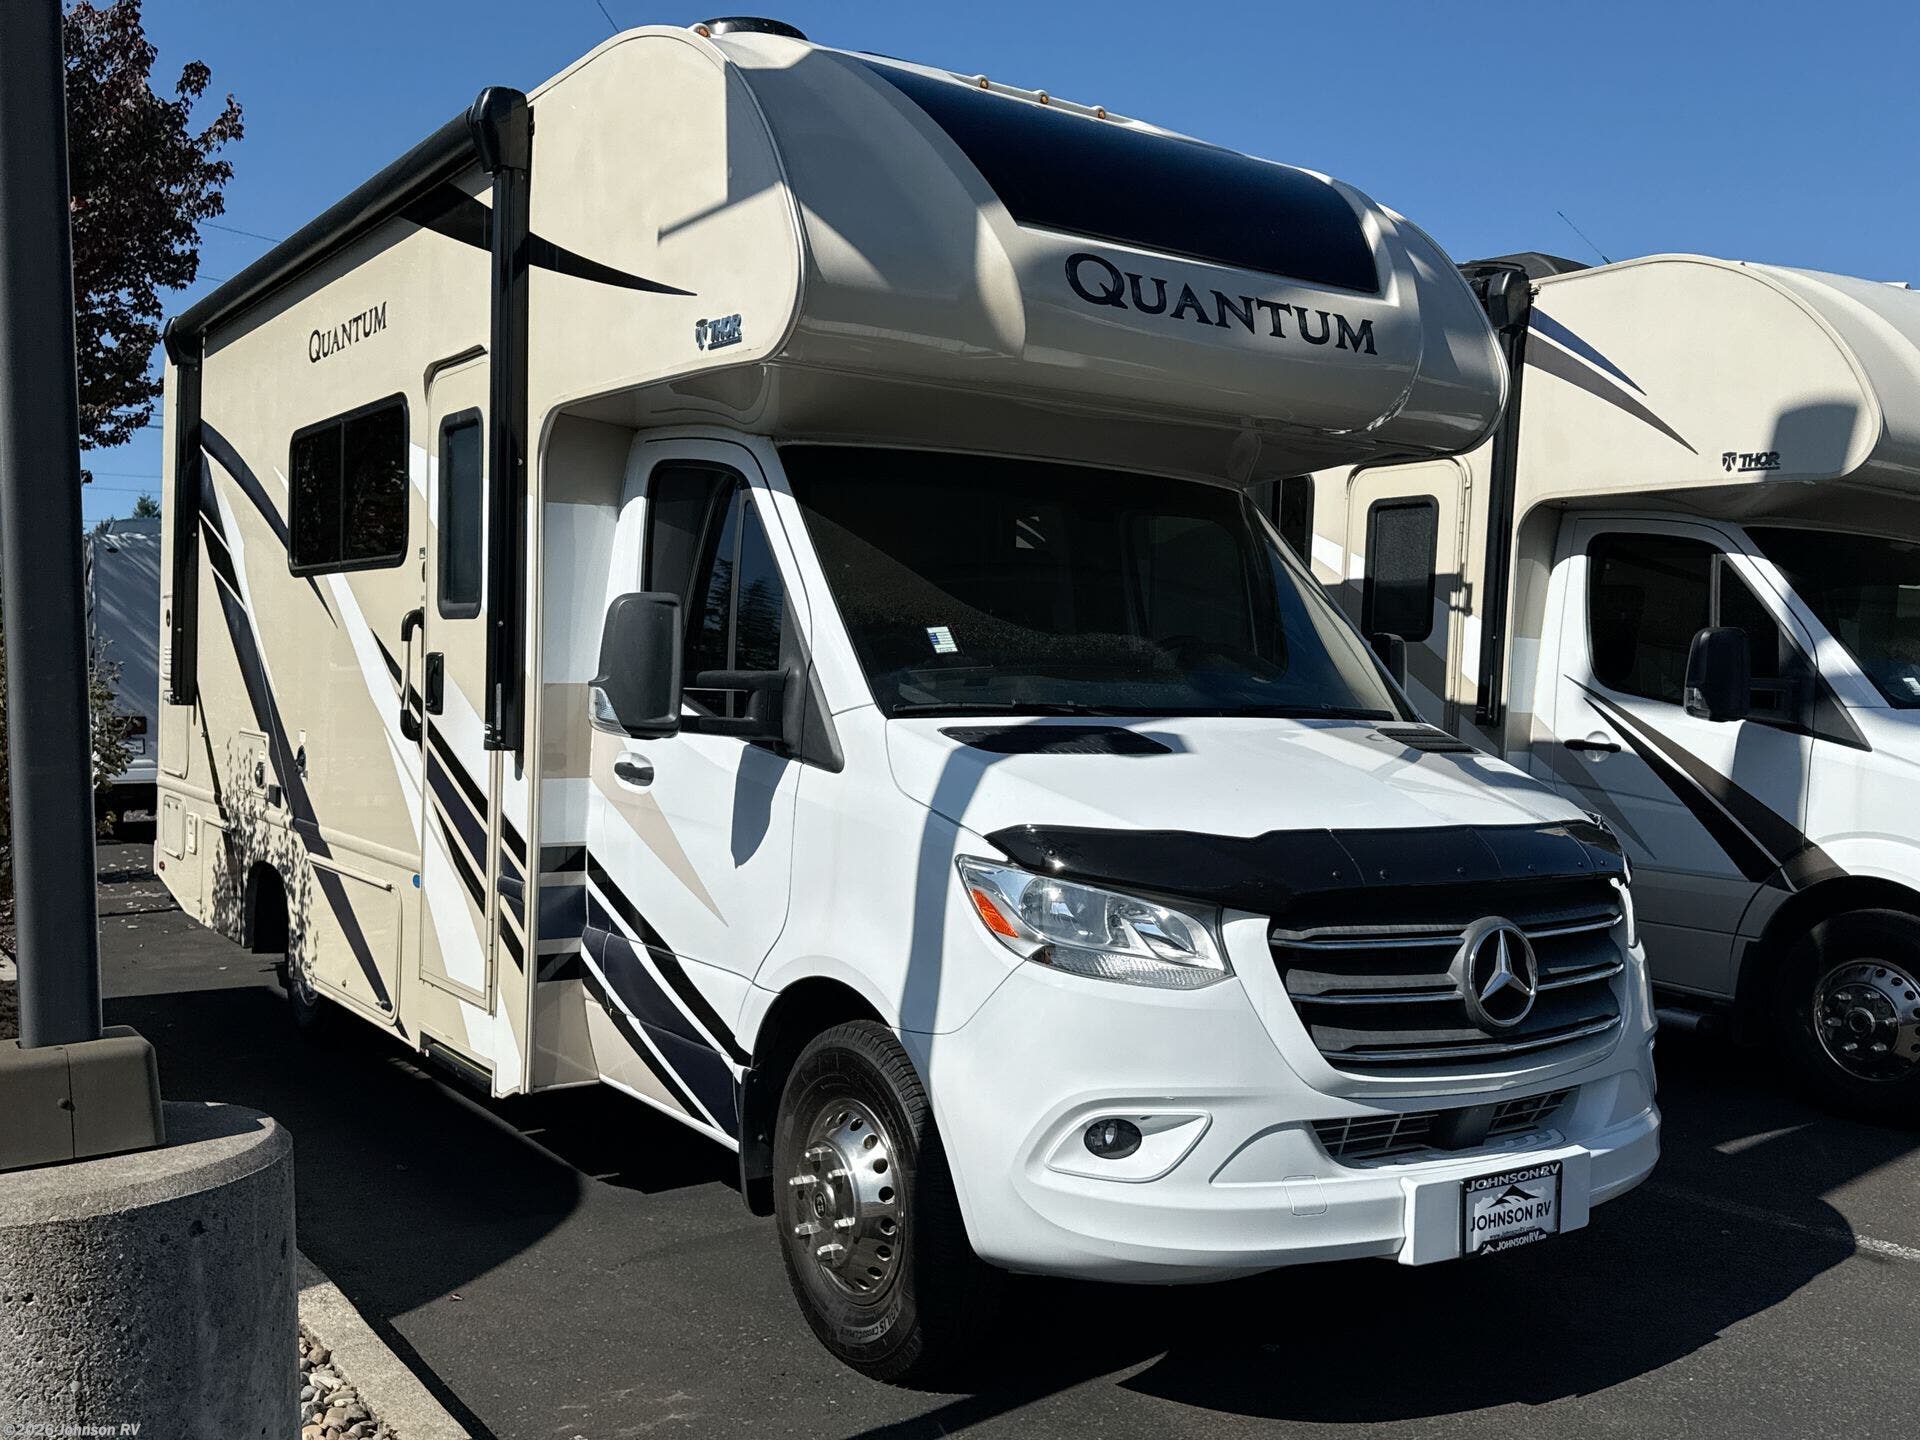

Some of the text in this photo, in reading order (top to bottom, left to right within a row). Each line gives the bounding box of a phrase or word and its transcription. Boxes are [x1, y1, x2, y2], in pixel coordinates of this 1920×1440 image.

[1065, 253, 1378, 355] QUANTUM
[309, 301, 387, 363] QUANTUM
[708, 314, 742, 342] THOR
[1739, 451, 1780, 468] THOR
[1470, 1200, 1552, 1232] JOHNSON RV
